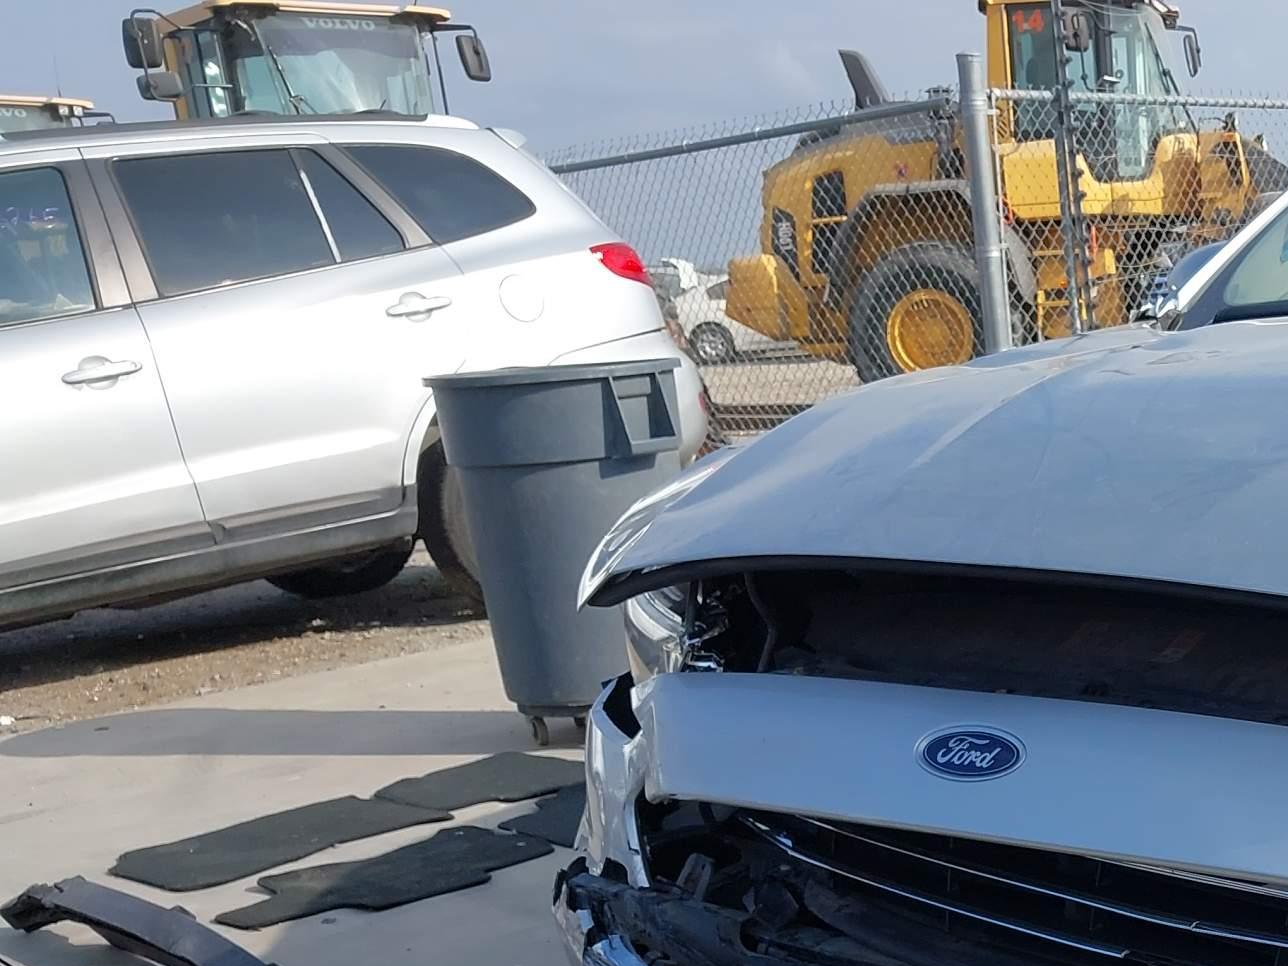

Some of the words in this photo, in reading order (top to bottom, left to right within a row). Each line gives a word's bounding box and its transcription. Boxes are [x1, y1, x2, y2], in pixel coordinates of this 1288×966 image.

[301, 17, 375, 31] VOLVO
[1012, 9, 1044, 33] 14
[936, 735, 1003, 769] Ford
